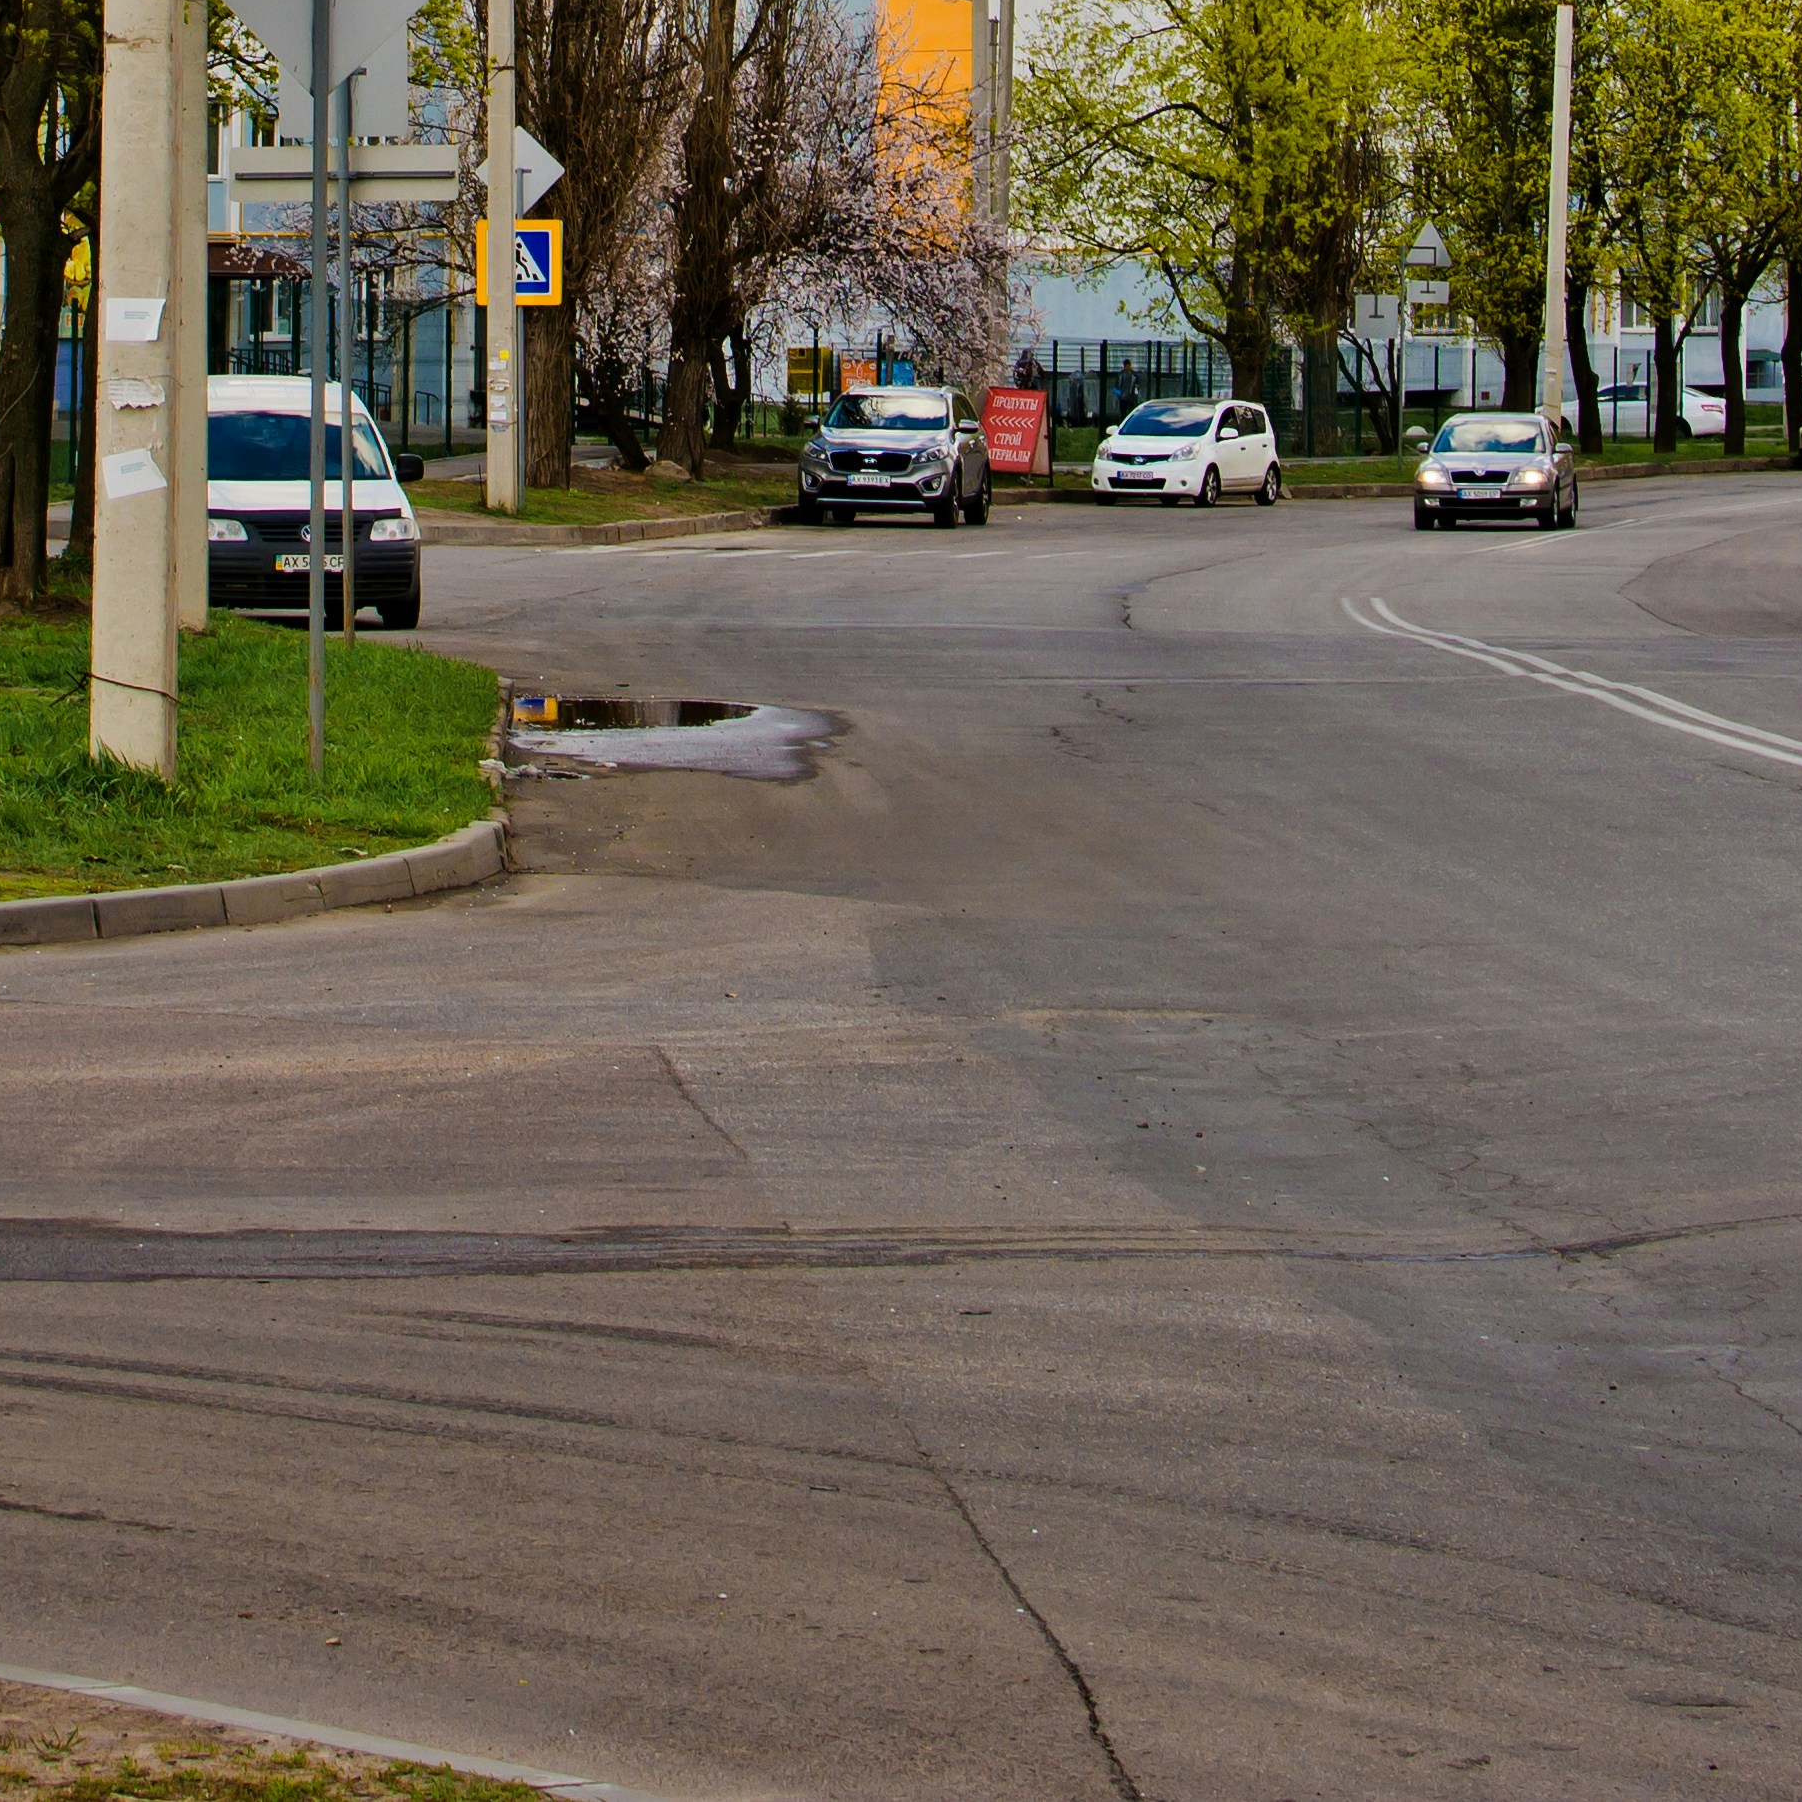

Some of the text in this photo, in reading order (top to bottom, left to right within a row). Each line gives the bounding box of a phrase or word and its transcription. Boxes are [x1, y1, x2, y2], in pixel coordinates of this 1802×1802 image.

[993, 396, 1038, 411] ПРОДУКТЫ
[994, 432, 1022, 446] СТРОЙ
[283, 556, 299, 568] AX
